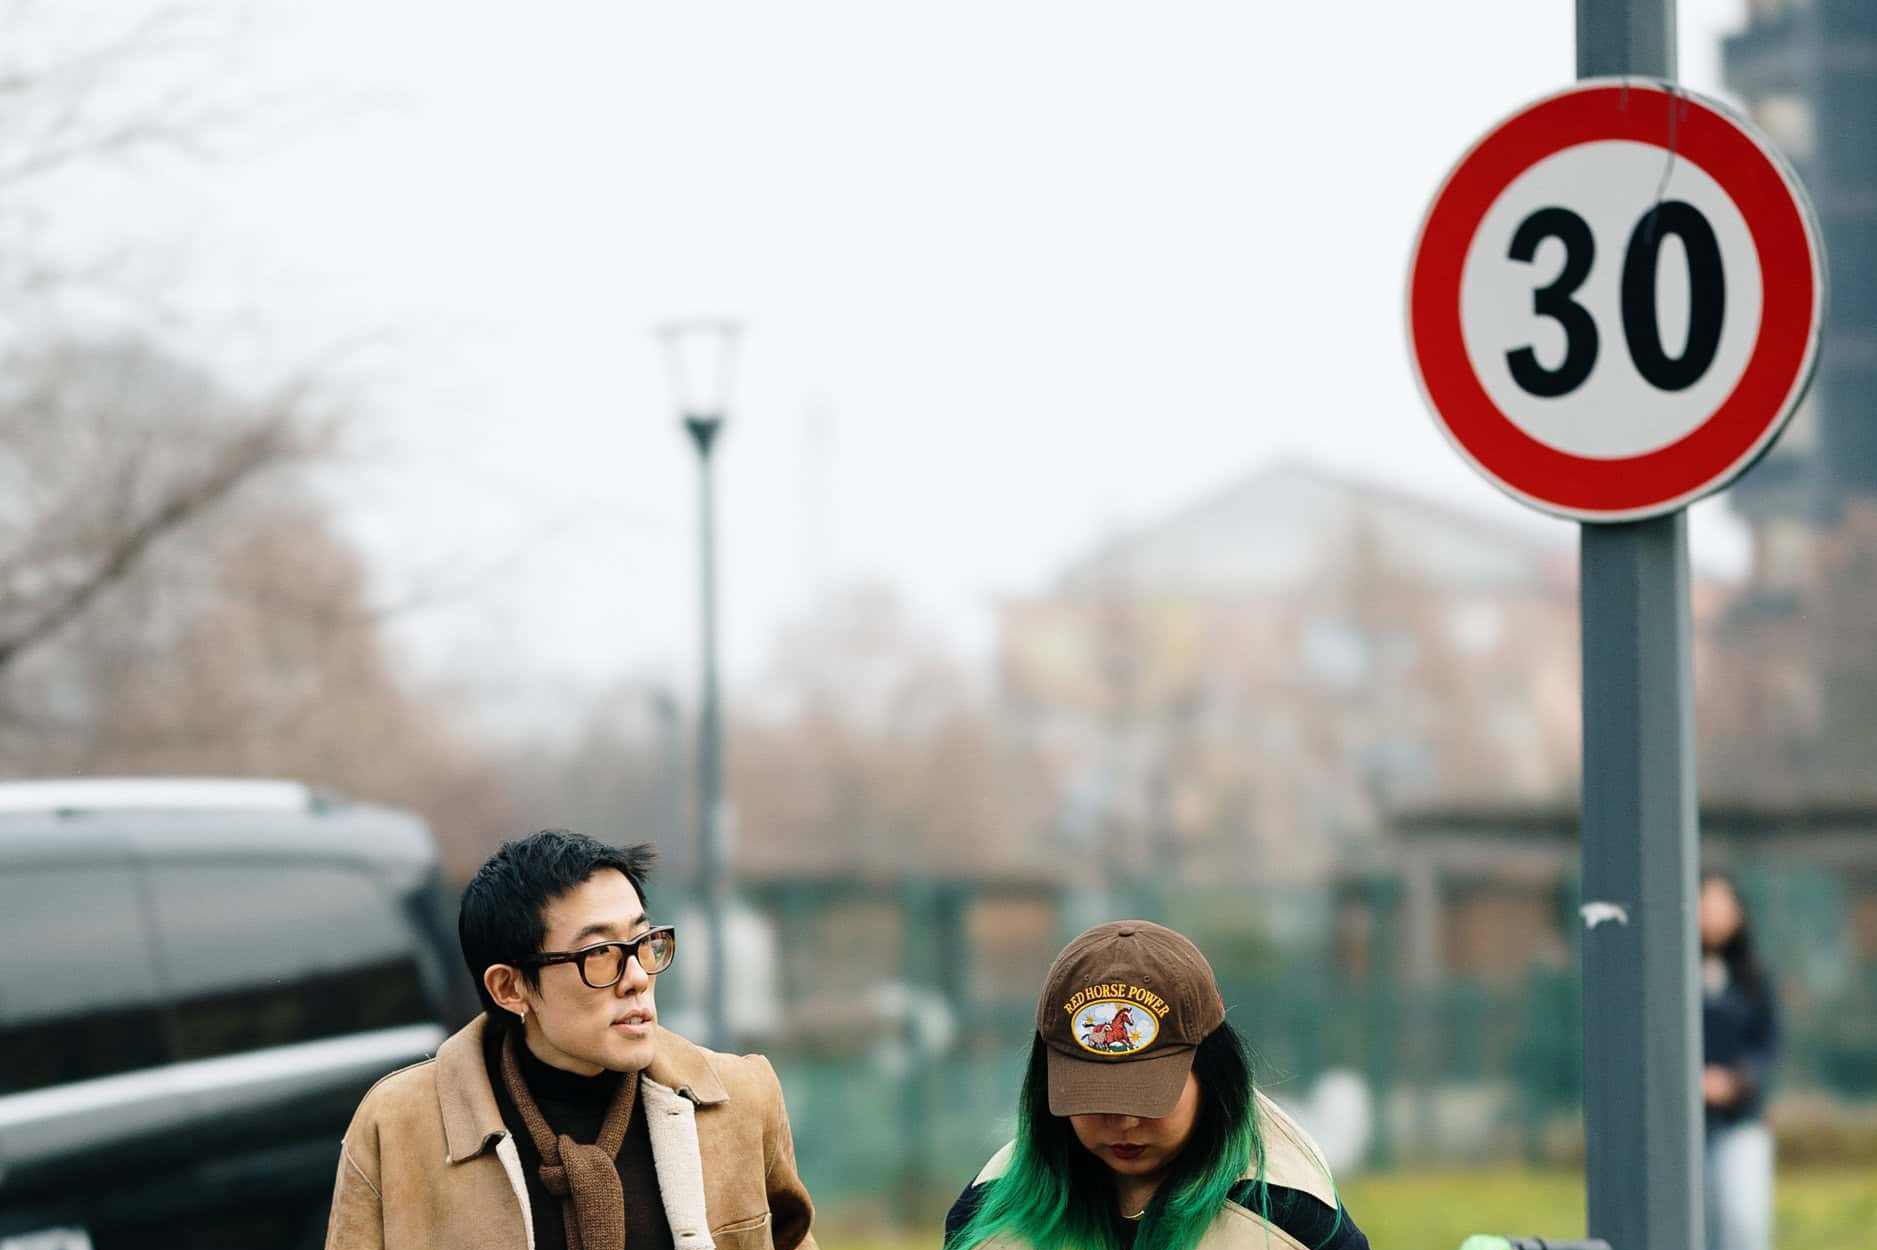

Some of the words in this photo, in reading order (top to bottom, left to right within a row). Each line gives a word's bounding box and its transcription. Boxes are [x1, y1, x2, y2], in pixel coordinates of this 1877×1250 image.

[1504, 200, 1726, 398] 30
[1063, 991, 1085, 1014] RED
[1084, 983, 1127, 1001] HORSE
[1127, 986, 1170, 1018] POWER
